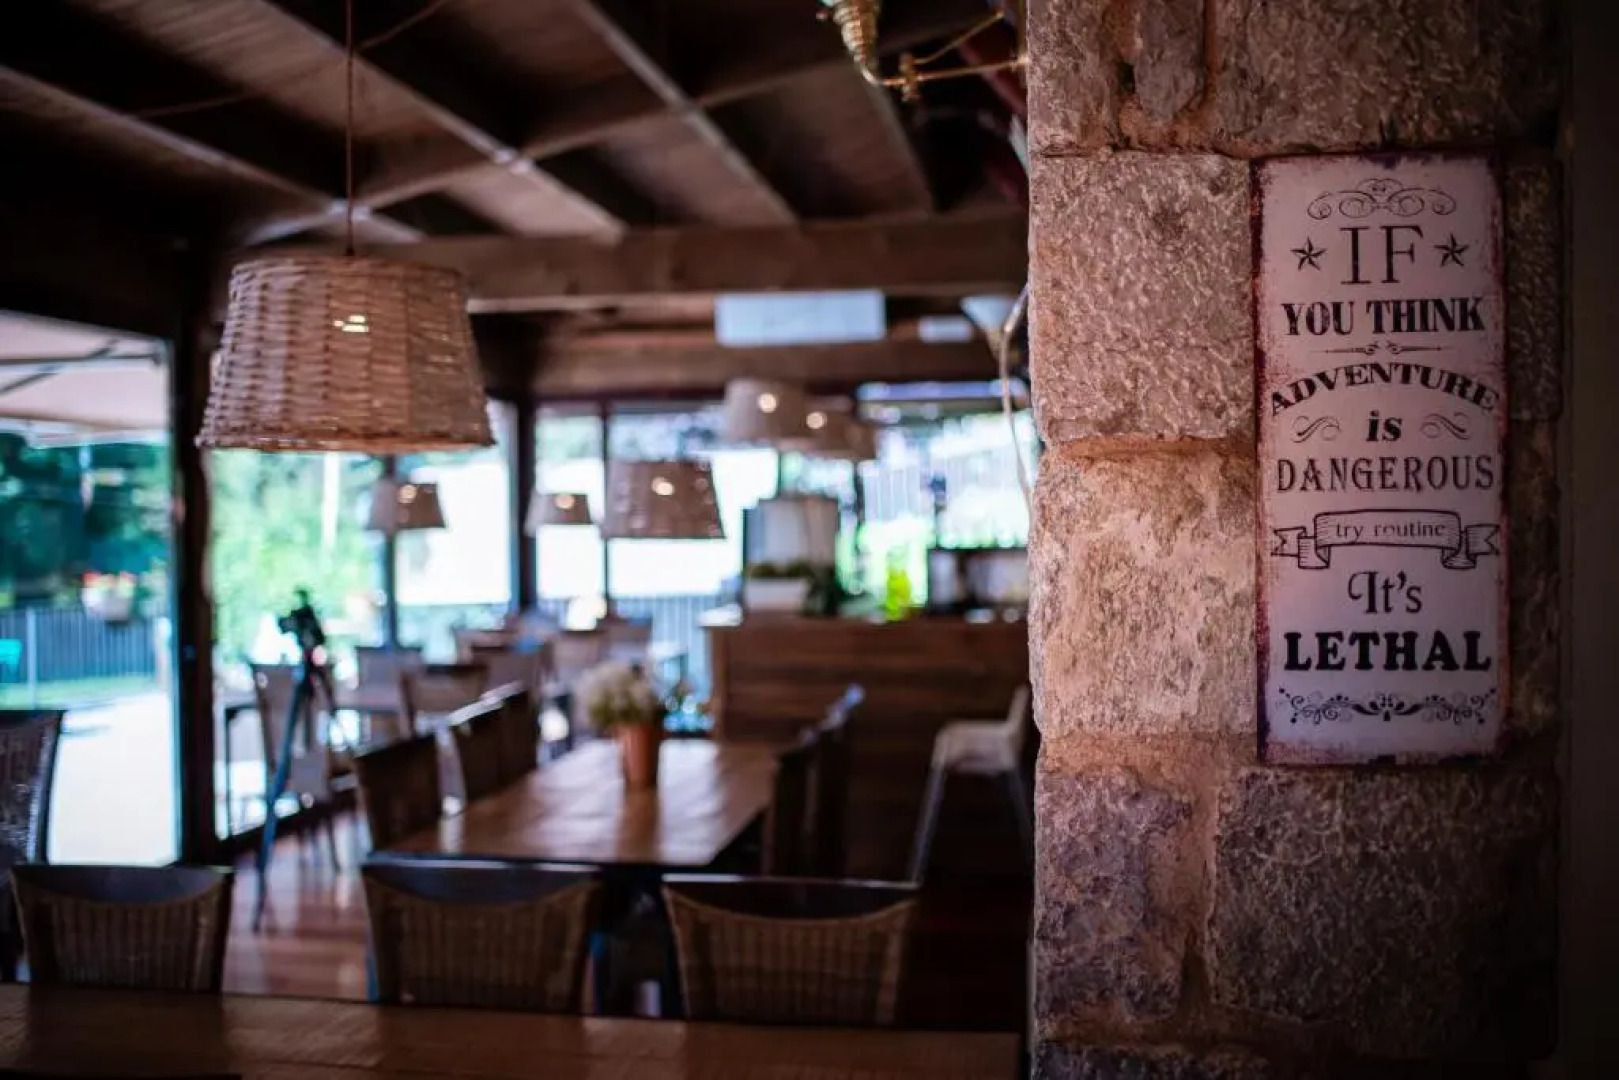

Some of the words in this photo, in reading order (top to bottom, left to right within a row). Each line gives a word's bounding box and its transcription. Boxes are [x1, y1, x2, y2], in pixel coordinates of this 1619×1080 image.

[1340, 225, 1424, 285] IF
[1281, 301, 1355, 336] YOU
[1366, 297, 1486, 334] THINK
[1271, 362, 1499, 416] ADVENTURE
[1366, 410, 1403, 442] is
[1277, 455, 1494, 492] DANGEROUS
[1336, 522, 1364, 543] try
[1374, 520, 1446, 538] routine
[1347, 571, 1423, 614] It's
[1284, 630, 1492, 671] LETHAL
